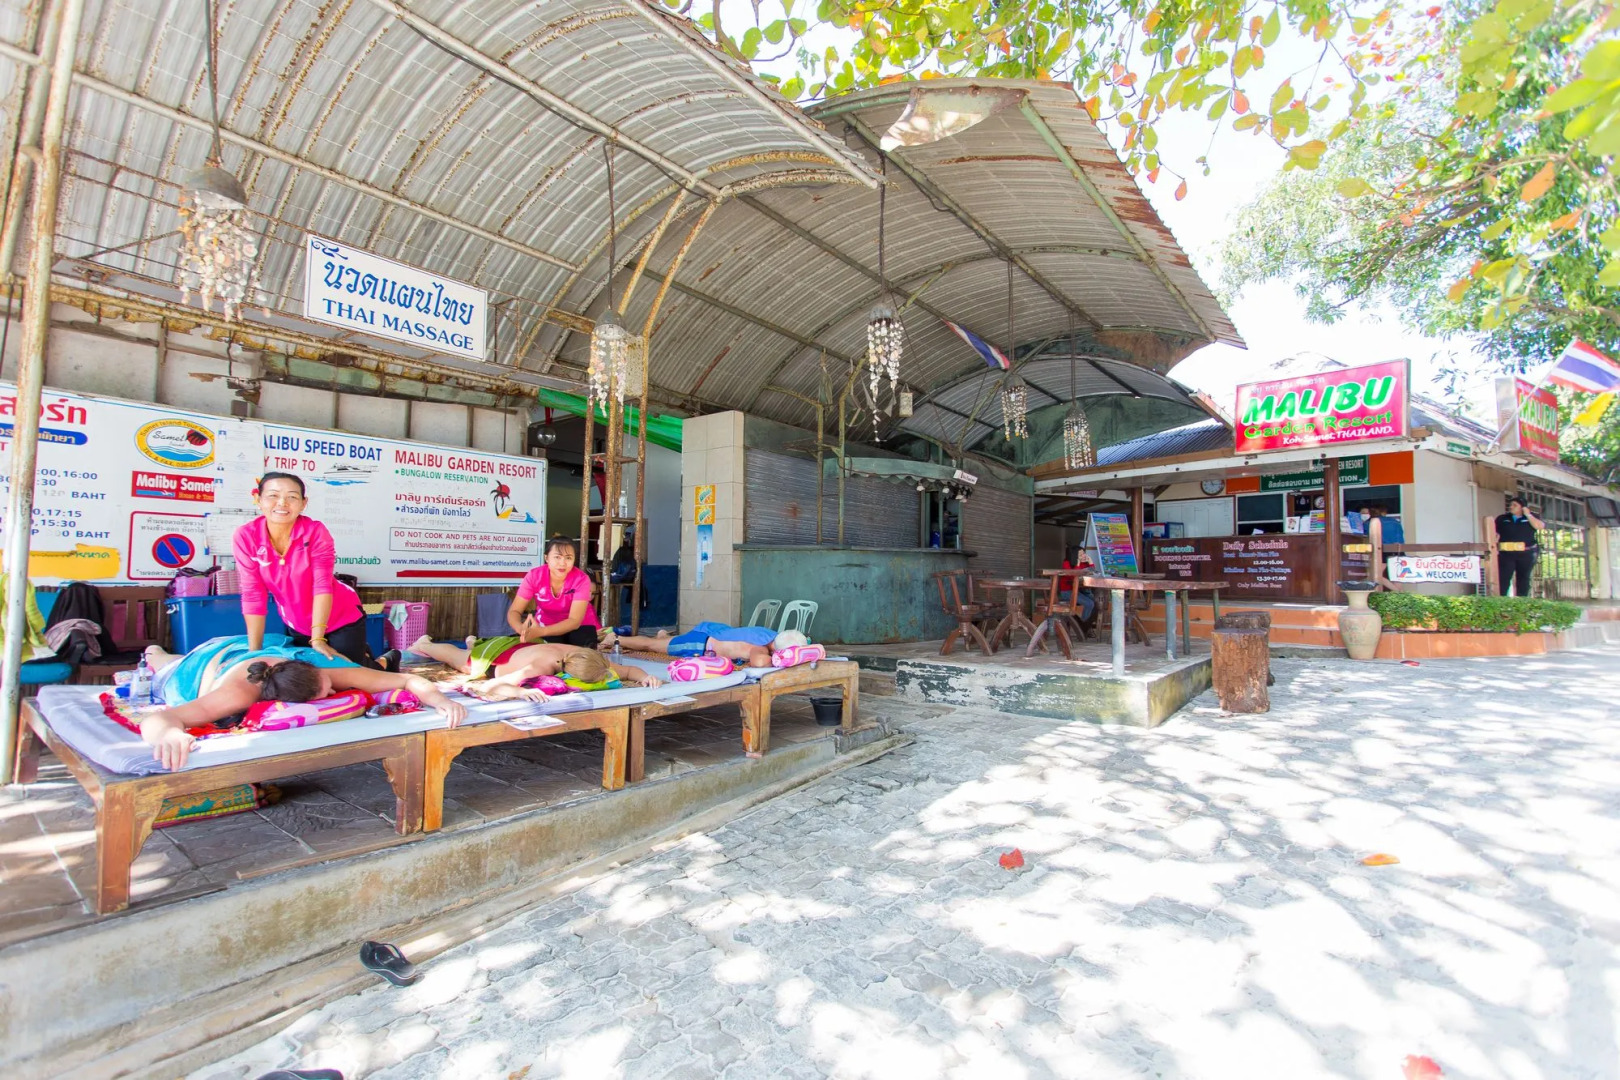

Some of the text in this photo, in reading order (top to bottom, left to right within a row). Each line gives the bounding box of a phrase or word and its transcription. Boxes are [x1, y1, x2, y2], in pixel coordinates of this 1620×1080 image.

[324, 261, 475, 325] นวดแผนไทย
[323, 298, 474, 350] THAI MASSAGE
[1242, 376, 1395, 425] MALIBU
[1519, 392, 1557, 436] MALIBU
[140, 423, 159, 436] Samet
[159, 419, 182, 428] Island
[183, 421, 198, 430] Tour
[1244, 410, 1393, 439] Garden Resort
[152, 430, 185, 442] Samet
[305, 439, 345, 457] SPEED
[350, 445, 382, 461] BOAT
[275, 457, 297, 469] TRIP
[302, 459, 315, 471] TO
[395, 450, 537, 479] MALIBU GARDEN RESORT
[1345, 459, 1364, 469] RESORT
[136, 473, 214, 493] Malibu Samet
[401, 468, 488, 484] BUNGALOW RESERVATION
[71, 491, 106, 500] BAHT
[76, 530, 110, 539] BAHT
[507, 536, 535, 544] ALLOWED
[1222, 539, 1289, 552] Daily Schedule
[390, 557, 461, 566] www.malibu-samet.com
[1415, 558, 1473, 570] ยินดีต้อนรับ
[1426, 571, 1468, 579] WELCOME
